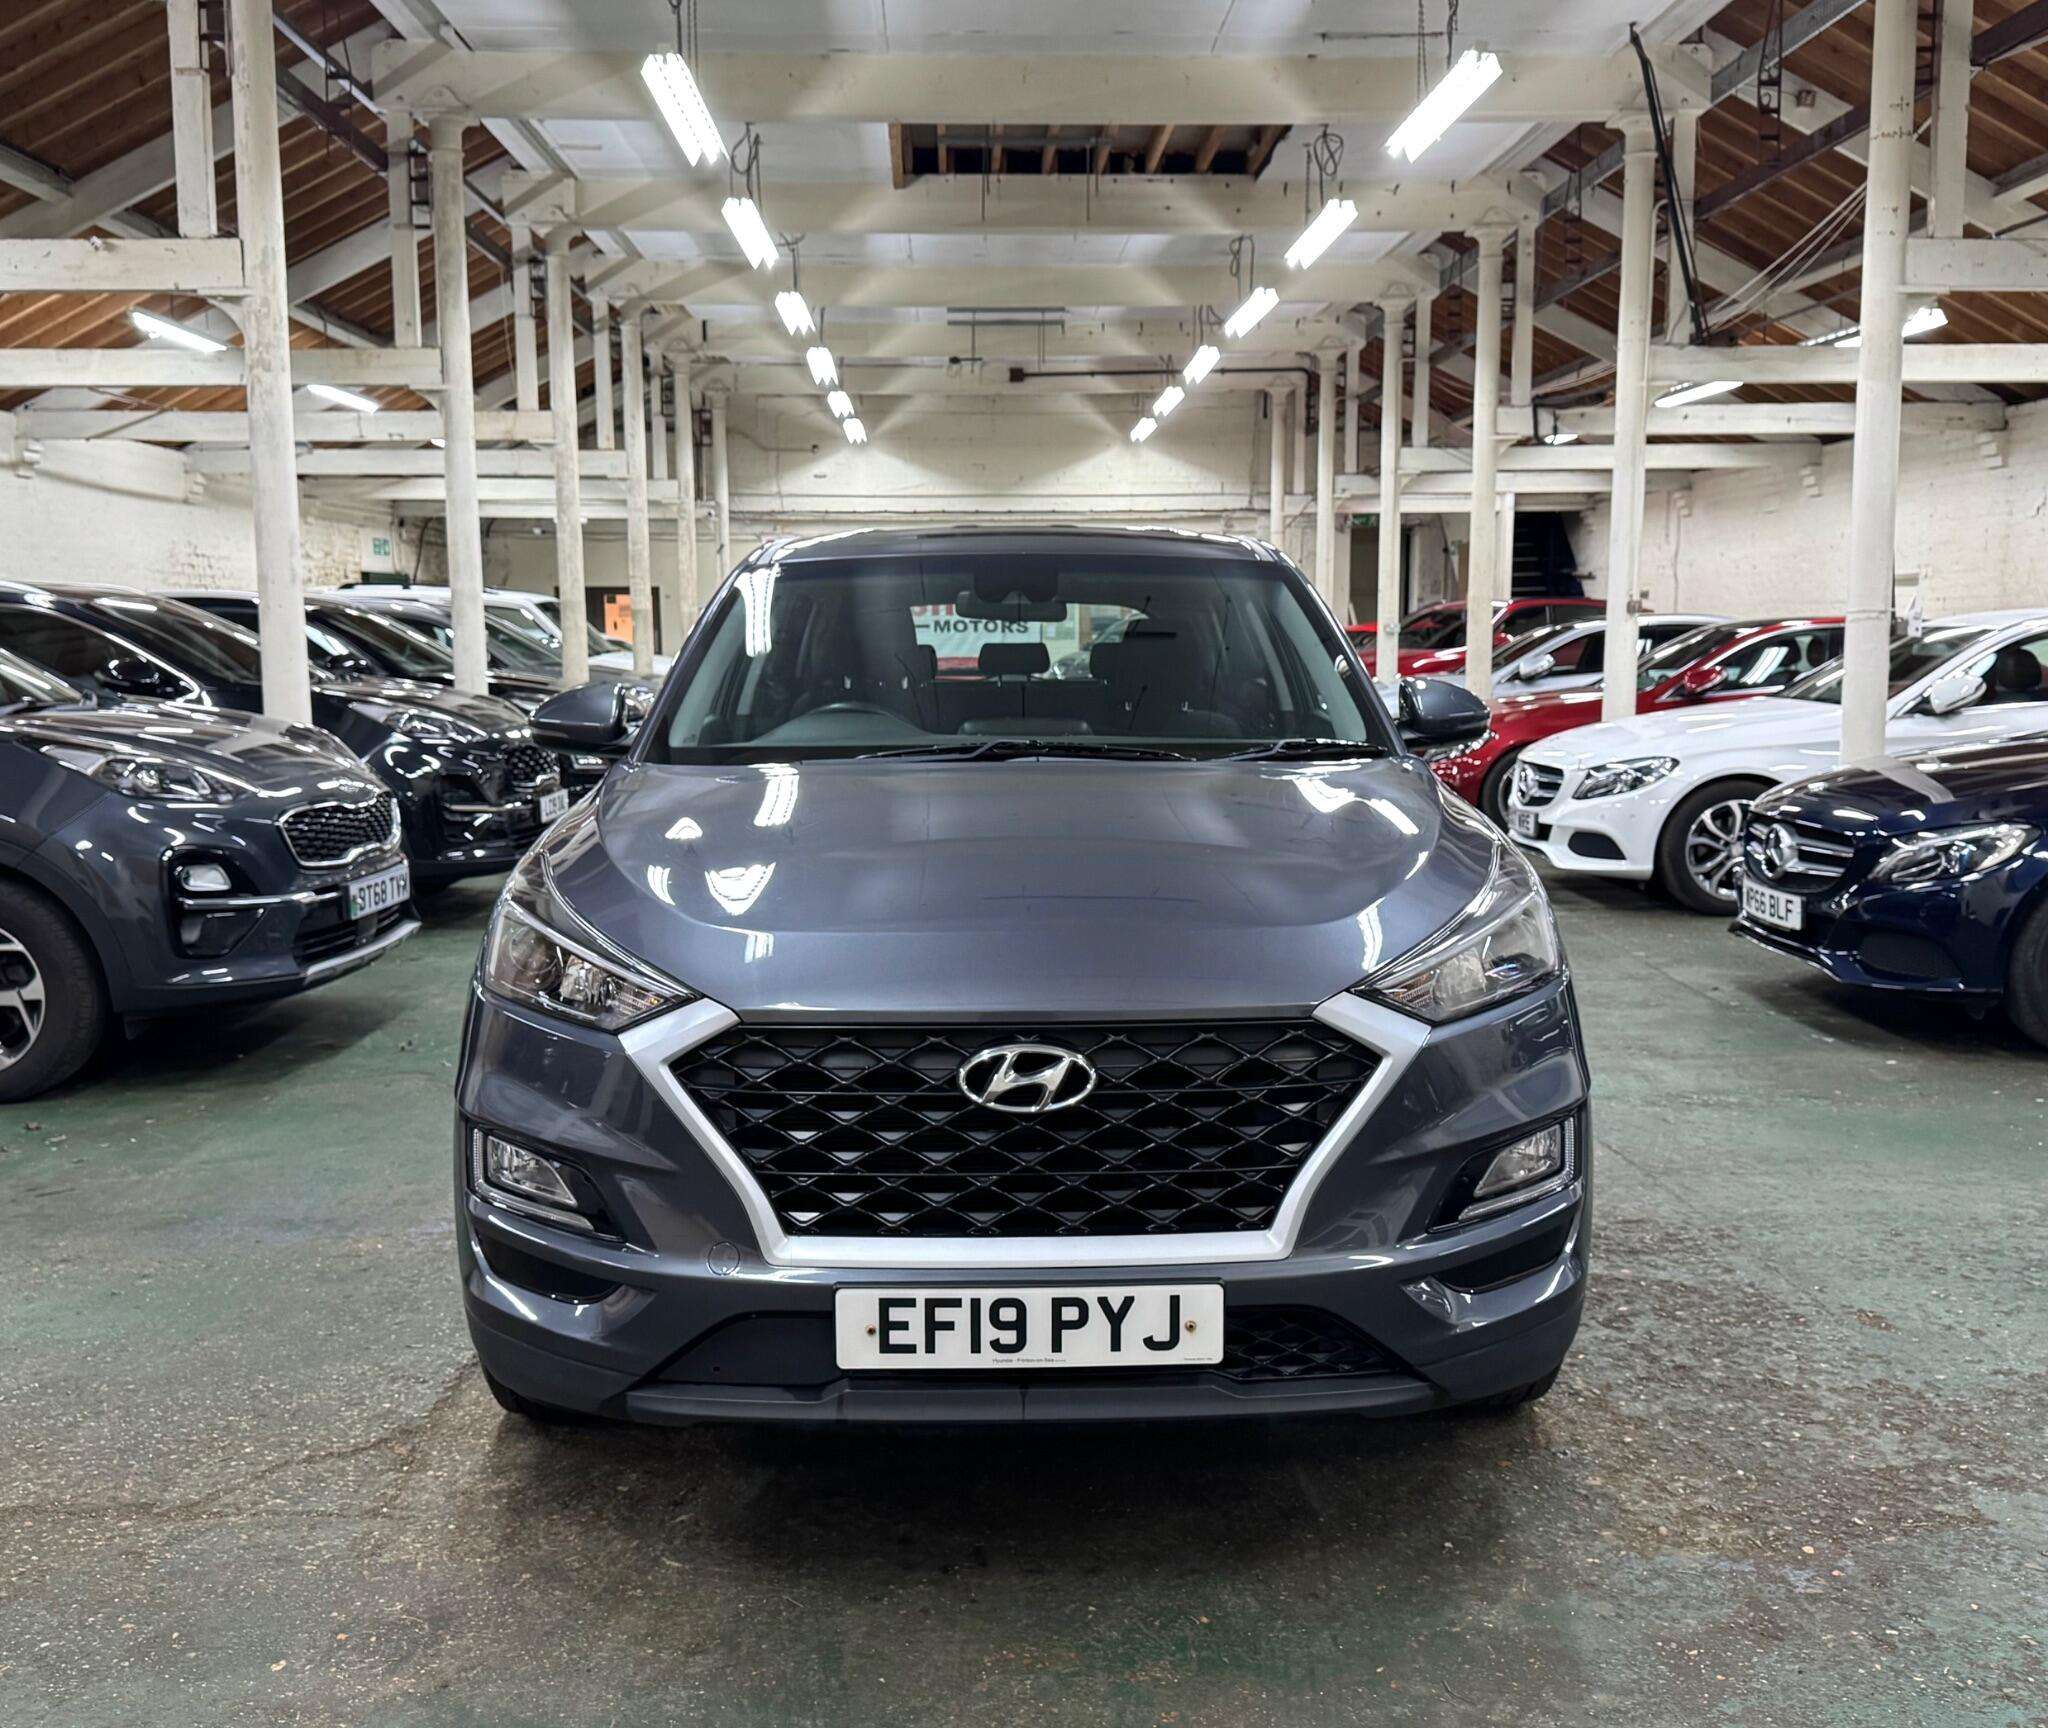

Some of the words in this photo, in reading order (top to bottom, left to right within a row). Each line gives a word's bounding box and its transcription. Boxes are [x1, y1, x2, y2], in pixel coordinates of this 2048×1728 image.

[933, 620, 1029, 633] MOTORS
[1769, 894, 1794, 922] BLF
[878, 1297, 1027, 1354] EF19
[1051, 1295, 1181, 1353] PYJ
